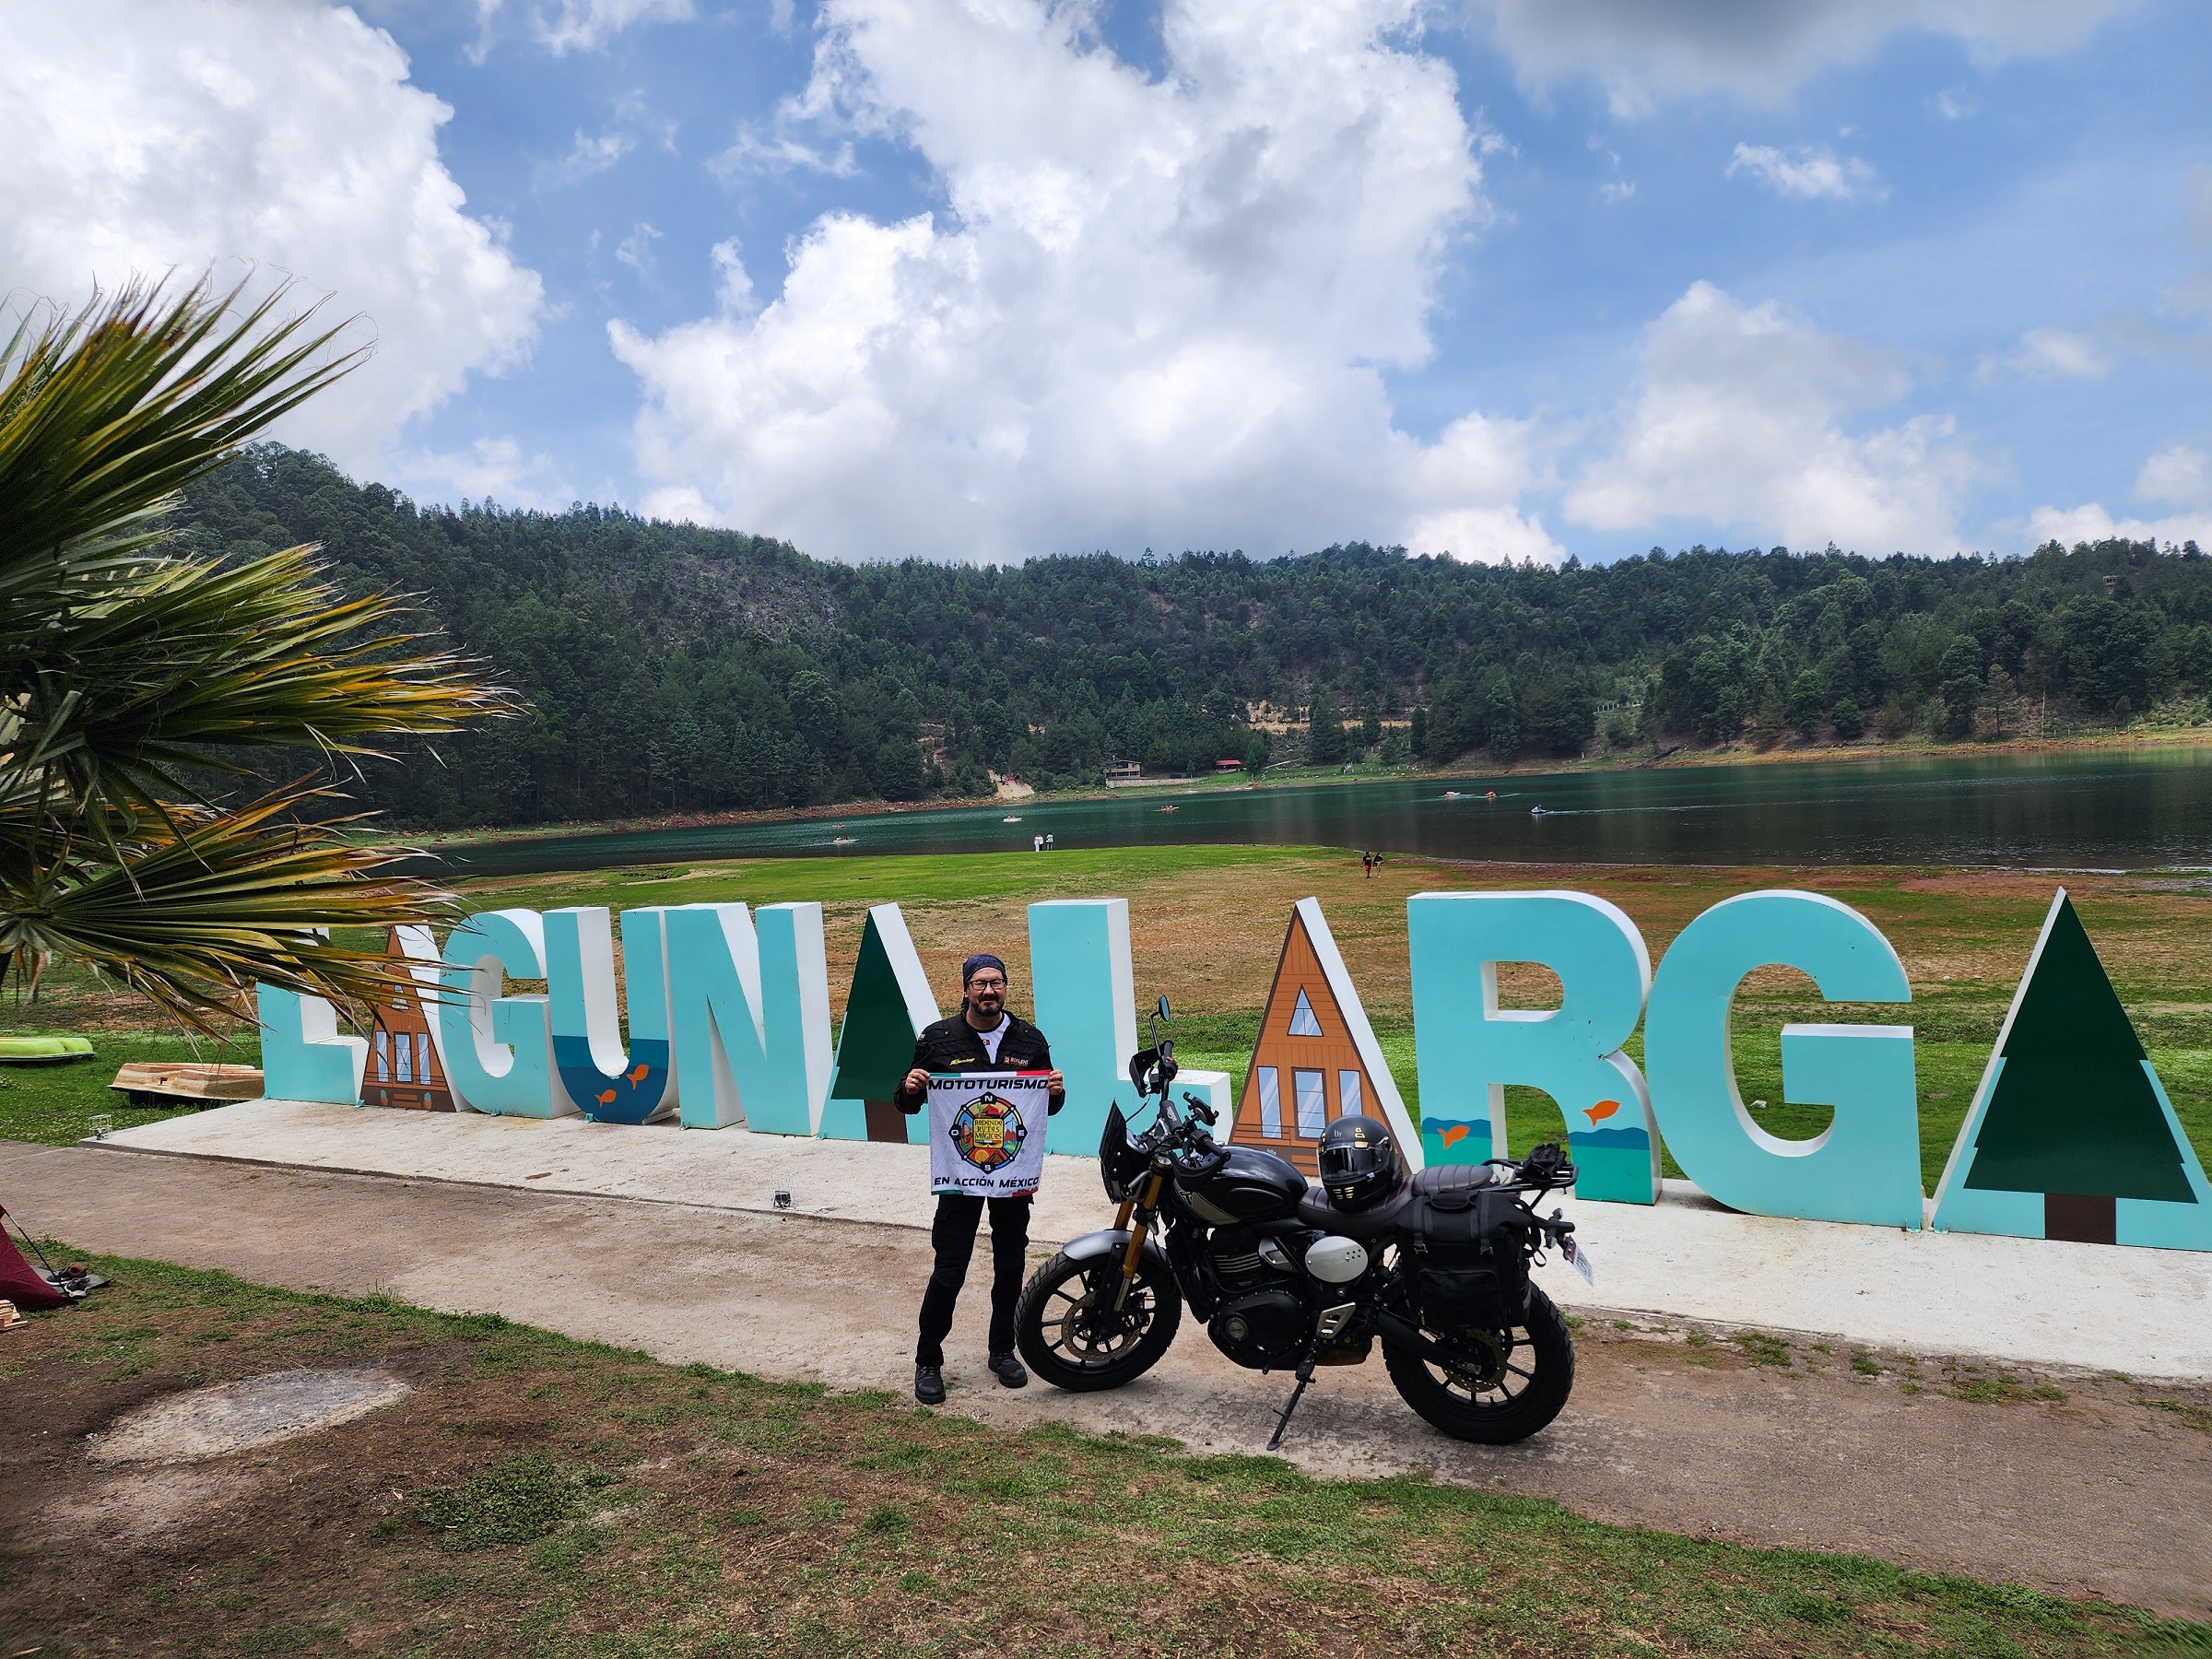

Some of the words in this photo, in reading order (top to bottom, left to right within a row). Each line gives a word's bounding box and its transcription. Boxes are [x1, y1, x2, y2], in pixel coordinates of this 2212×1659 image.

[256, 901, 938, 1144] LAGUNA
[1028, 886, 2212, 1252] LARGA
[928, 1078, 1049, 1090] MOTOTURISMO
[934, 1176, 950, 1186] EN
[954, 1176, 994, 1188] ACCIÓN
[999, 1176, 1040, 1188] MÉXICO
